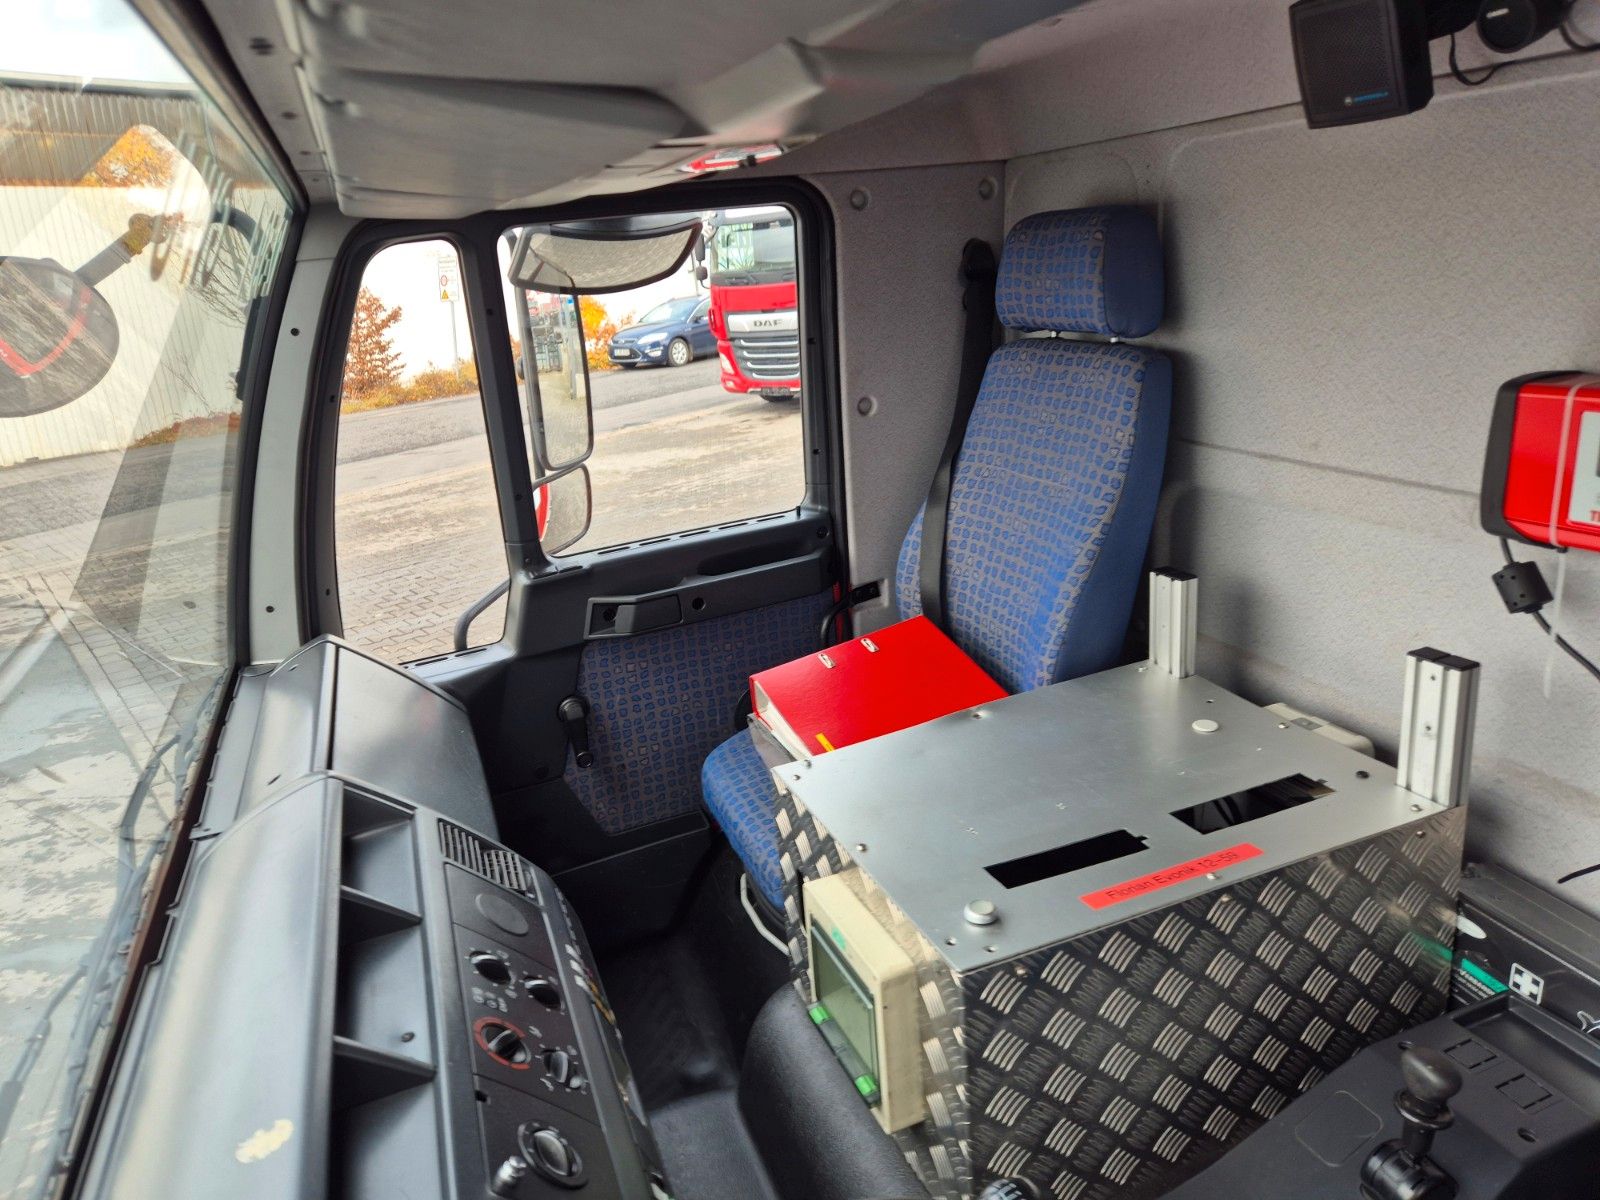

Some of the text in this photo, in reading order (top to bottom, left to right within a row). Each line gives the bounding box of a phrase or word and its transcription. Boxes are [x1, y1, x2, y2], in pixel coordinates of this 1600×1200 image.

[753, 319, 783, 328] DAF
[1106, 880, 1153, 899] Florian
[1152, 868, 1197, 884] Evonik
